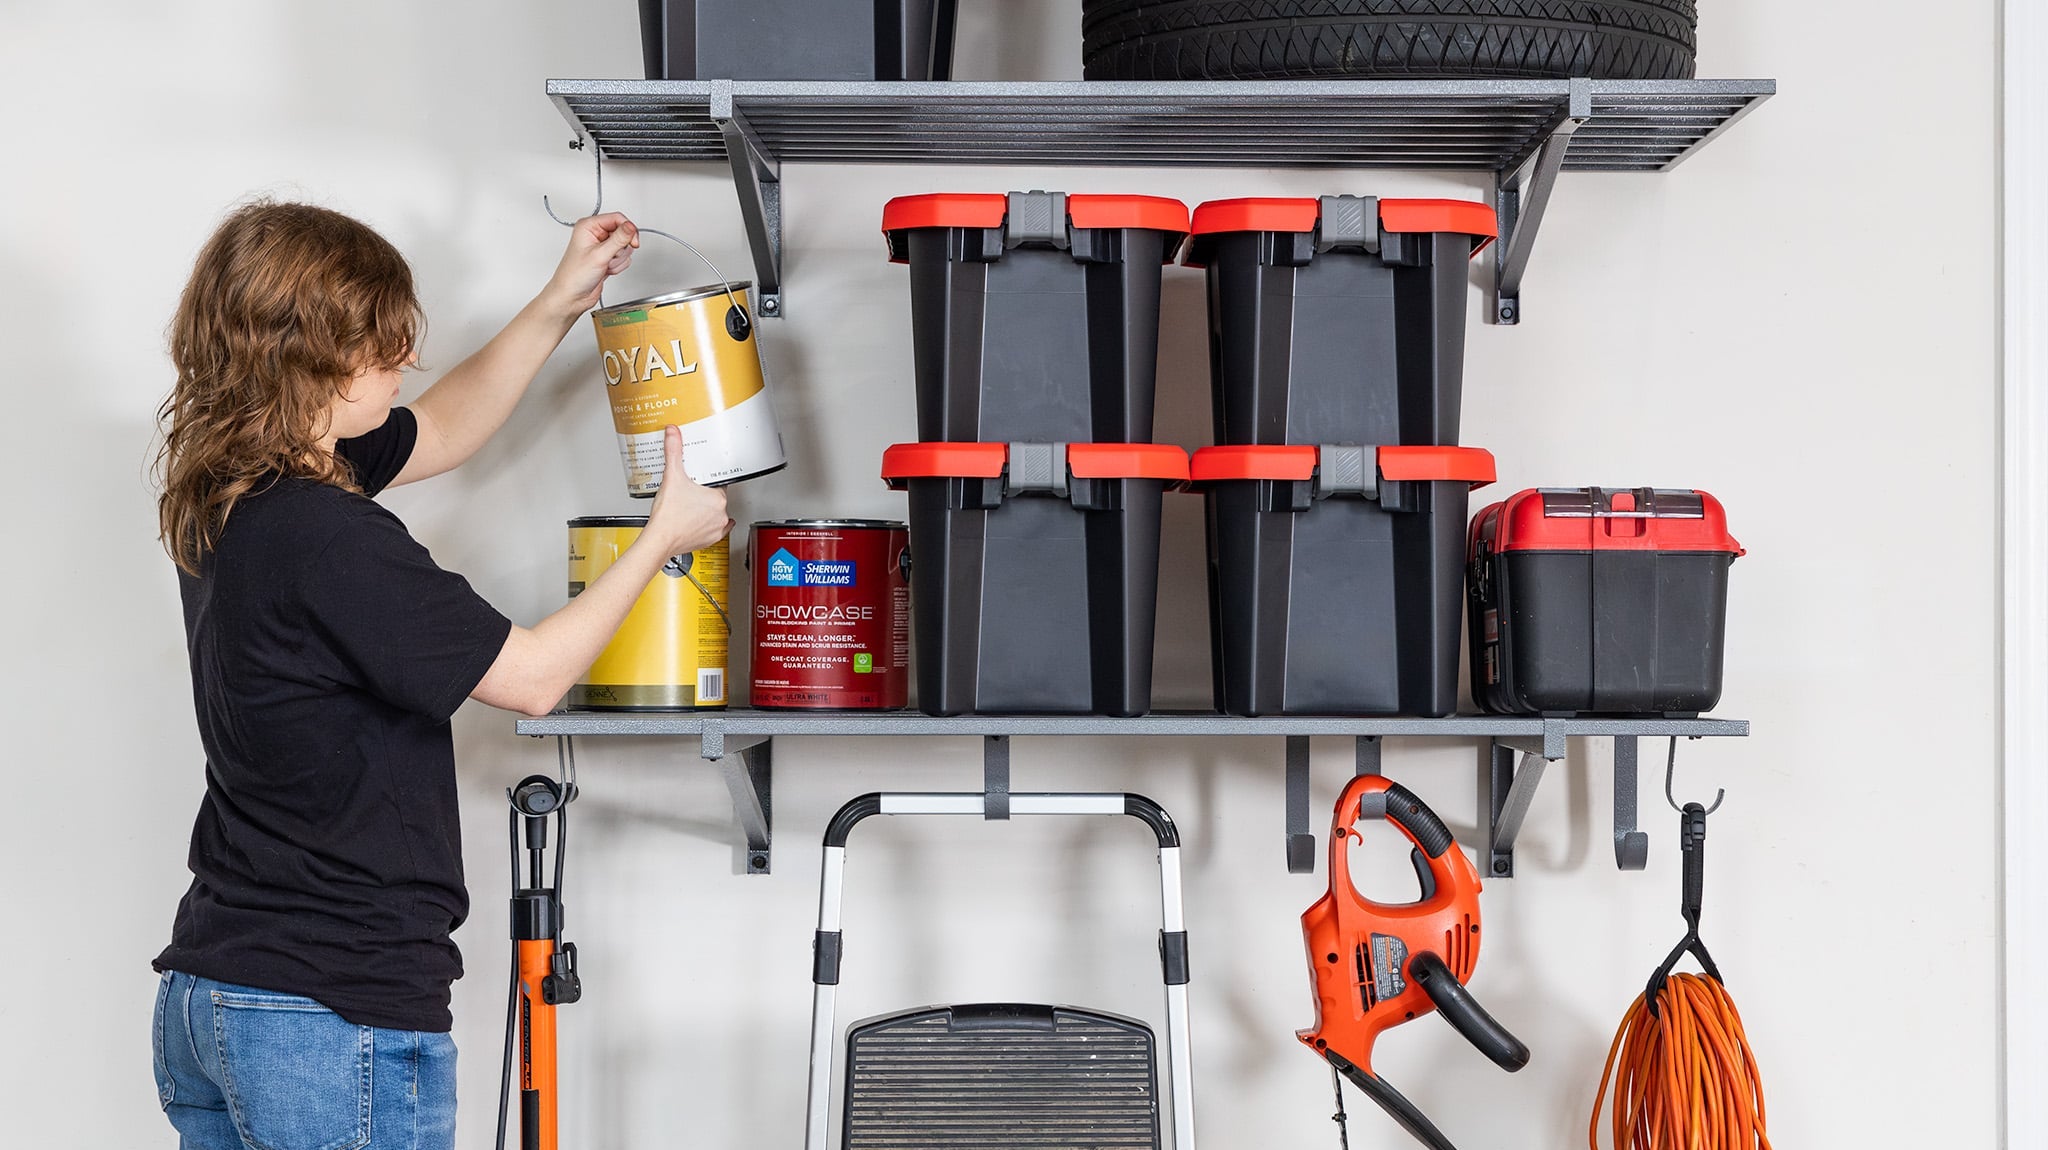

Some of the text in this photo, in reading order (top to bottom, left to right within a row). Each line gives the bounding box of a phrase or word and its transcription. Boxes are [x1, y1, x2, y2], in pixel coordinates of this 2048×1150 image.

[602, 339, 698, 386] OYAL
[636, 403, 642, 411] &
[644, 397, 678, 410] FLOOR
[771, 565, 794, 573] HGTV
[805, 563, 850, 574] SHERWIN
[771, 573, 794, 581] HOME
[804, 573, 850, 584] WILLIAMS
[756, 605, 873, 620] SHOWCASE
[766, 633, 786, 641] STAYS
[787, 634, 817, 643] CLEAN,
[770, 655, 804, 663] ONE-COAT
